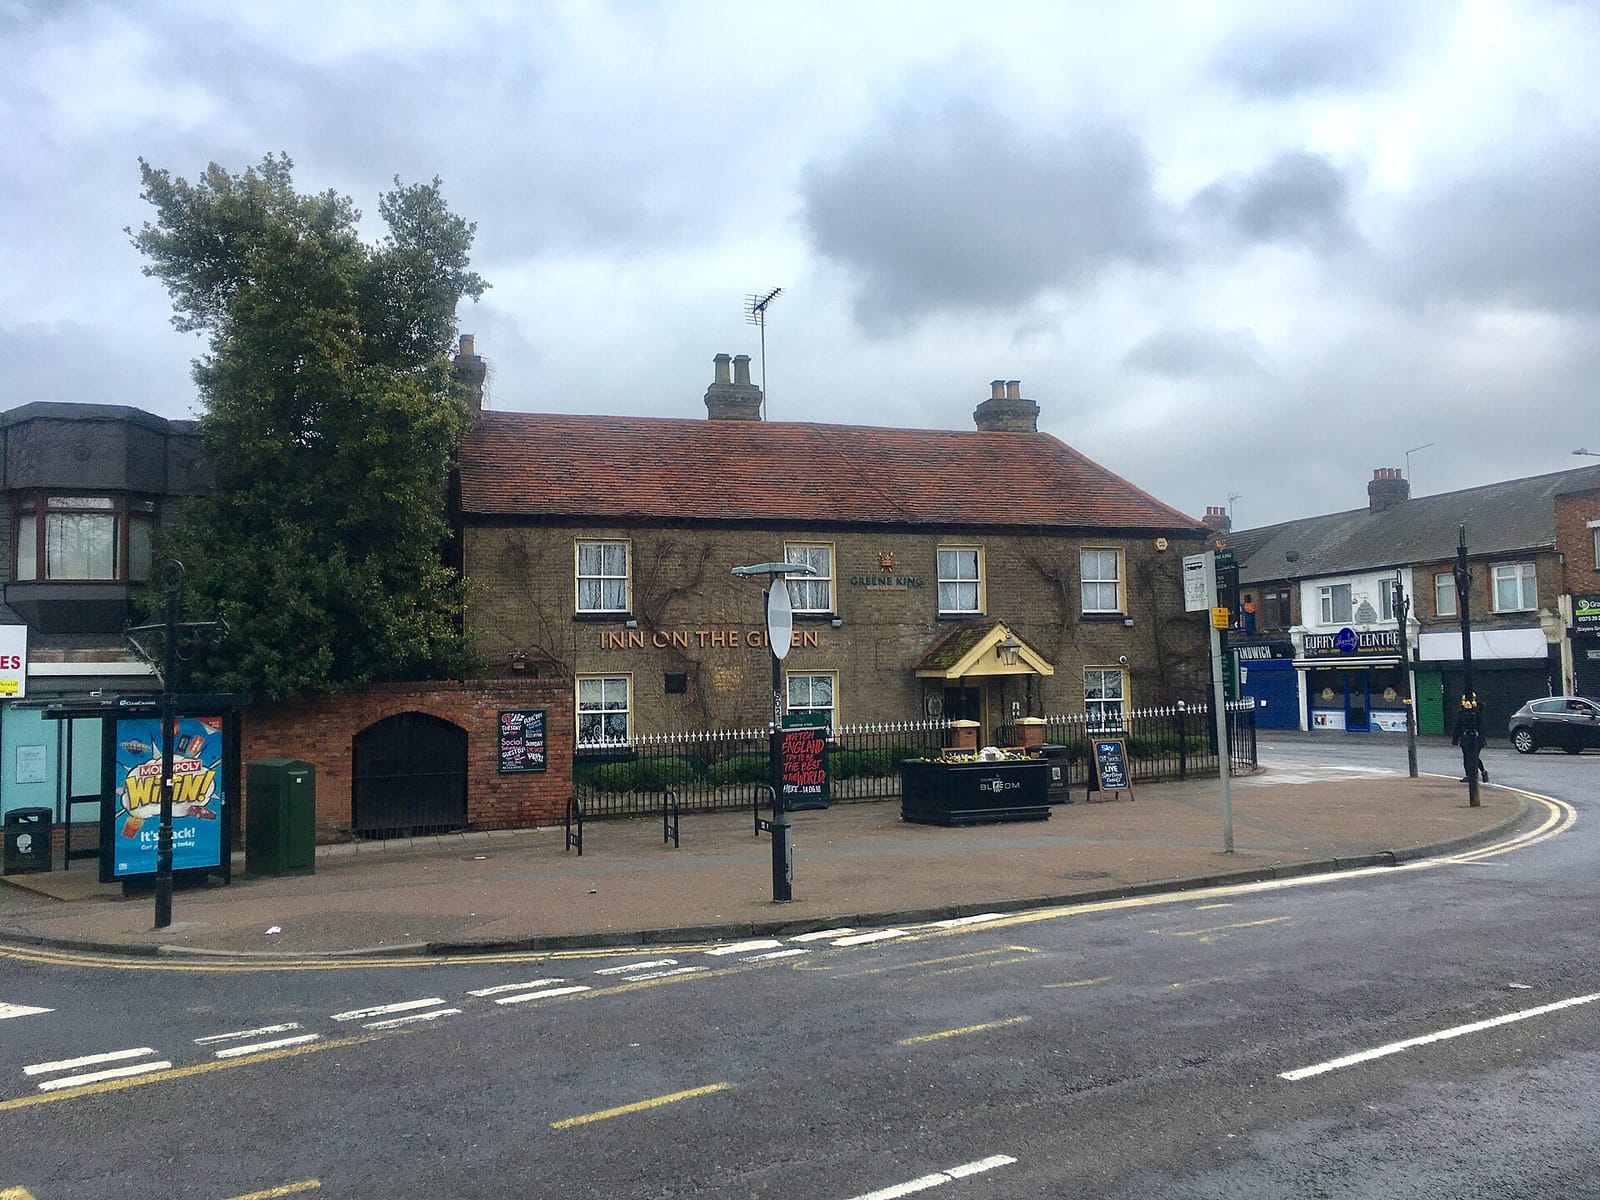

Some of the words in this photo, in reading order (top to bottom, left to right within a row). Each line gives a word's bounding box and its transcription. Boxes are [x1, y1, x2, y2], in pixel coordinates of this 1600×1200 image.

[851, 576, 892, 586] GREENE
[896, 576, 924, 586] KING
[600, 632, 644, 649] INN
[652, 631, 688, 648] ON
[696, 631, 739, 648] THE
[747, 630, 818, 648] GEN
[1305, 634, 1335, 649] CURRY
[1360, 632, 1399, 647] CENTRE
[786, 731, 815, 742] WATCH
[782, 740, 824, 754] ENGLAND
[142, 762, 200, 776] MOPOLY
[784, 761, 799, 772] THE
[801, 760, 822, 772] BEST
[141, 831, 160, 842] It's
[170, 827, 196, 840] ack!
